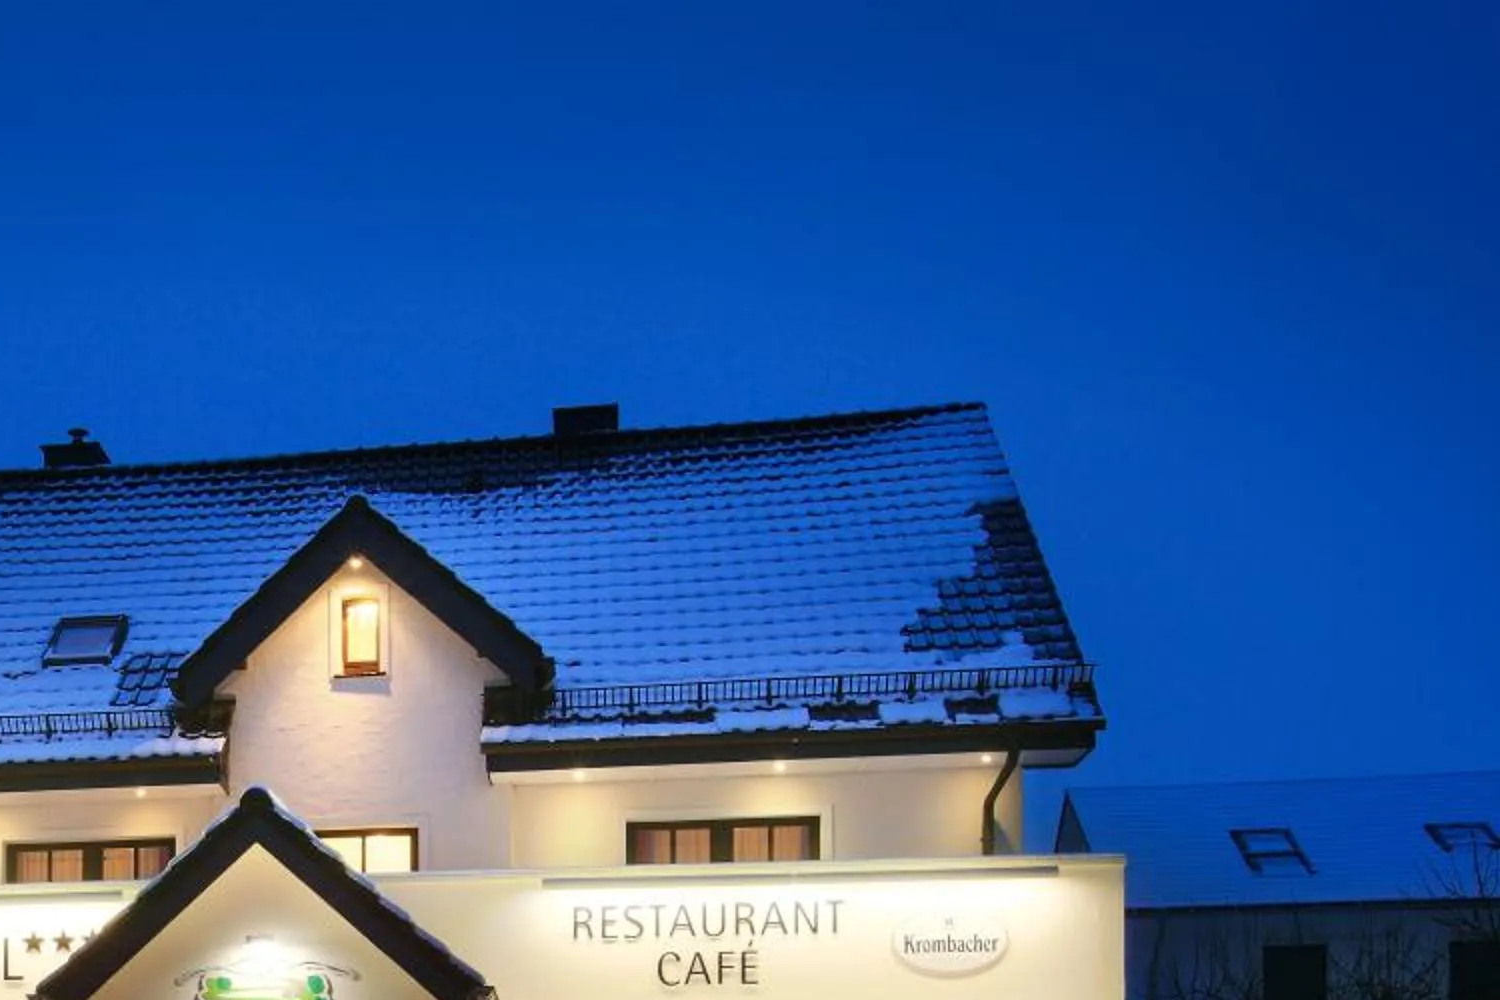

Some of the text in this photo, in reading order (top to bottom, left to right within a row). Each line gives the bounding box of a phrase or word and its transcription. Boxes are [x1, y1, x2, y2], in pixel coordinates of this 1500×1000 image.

[573, 900, 845, 941] RESTAURANT
[656, 940, 760, 986] CAFÉ
[903, 933, 998, 954] Krombacher
